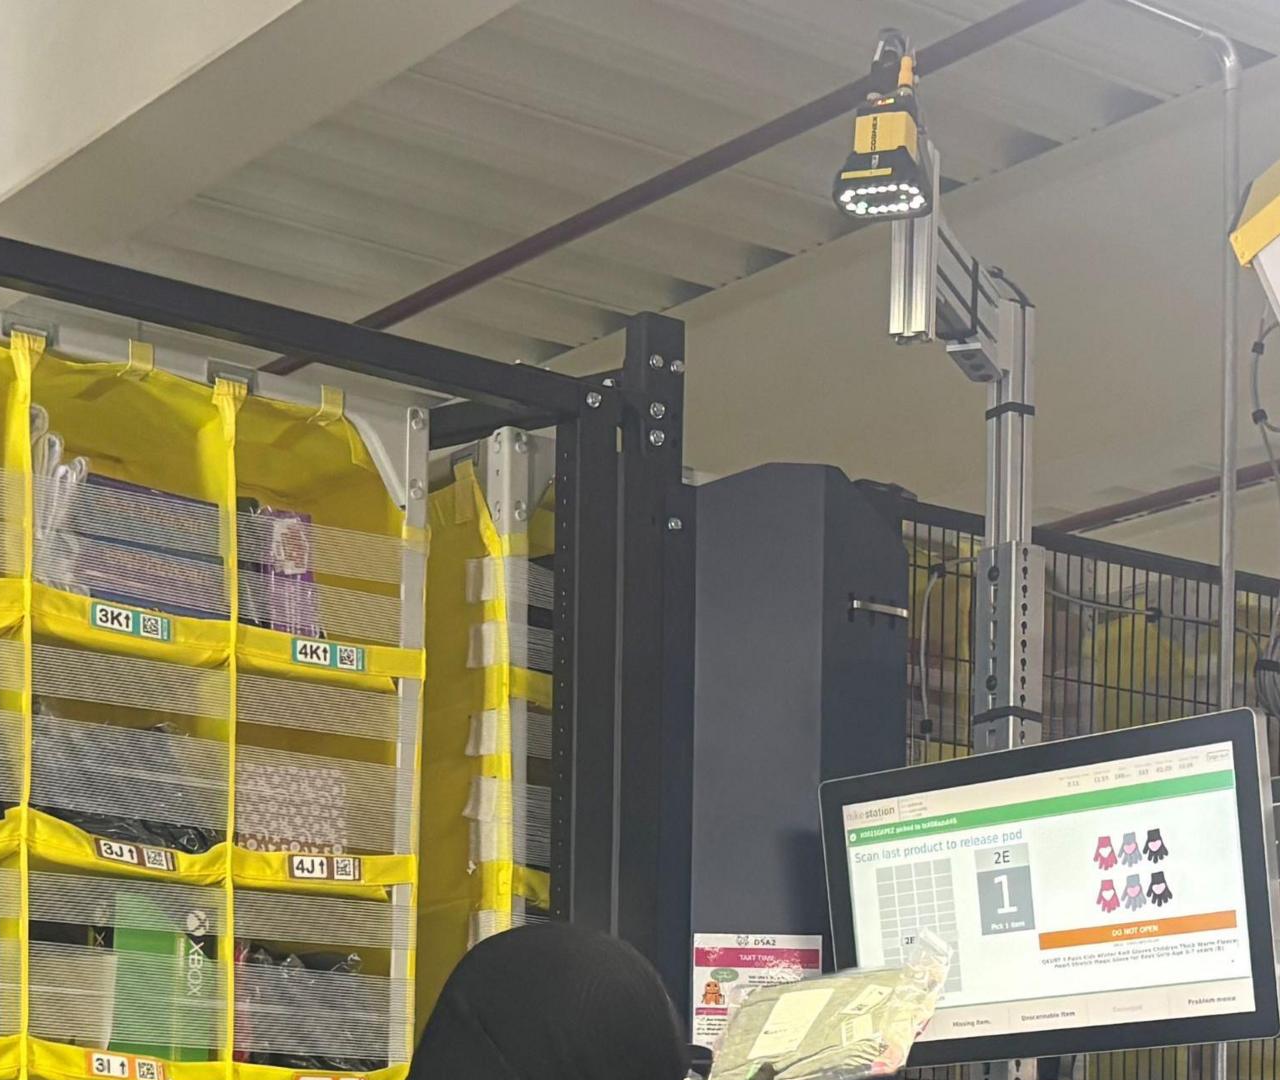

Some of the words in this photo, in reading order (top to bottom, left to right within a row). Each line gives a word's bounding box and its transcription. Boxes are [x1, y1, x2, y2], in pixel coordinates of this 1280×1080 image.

[99, 608, 122, 627] 3K
[299, 644, 320, 661] 4K
[103, 842, 124, 858] 3J
[854, 852, 879, 864] Scan
[882, 846, 901, 859] last
[904, 841, 943, 858] product
[946, 838, 958, 849] to
[960, 833, 999, 848] release
[1002, 829, 1023, 844] pod
[994, 851, 1010, 864] 2E
[296, 859, 315, 874] 4J
[994, 874, 1018, 914] 1
[1112, 928, 1121, 936] DO
[1123, 926, 1138, 935] NOT
[1139, 924, 1159, 934] OPEN
[187, 939, 205, 996] XBOX
